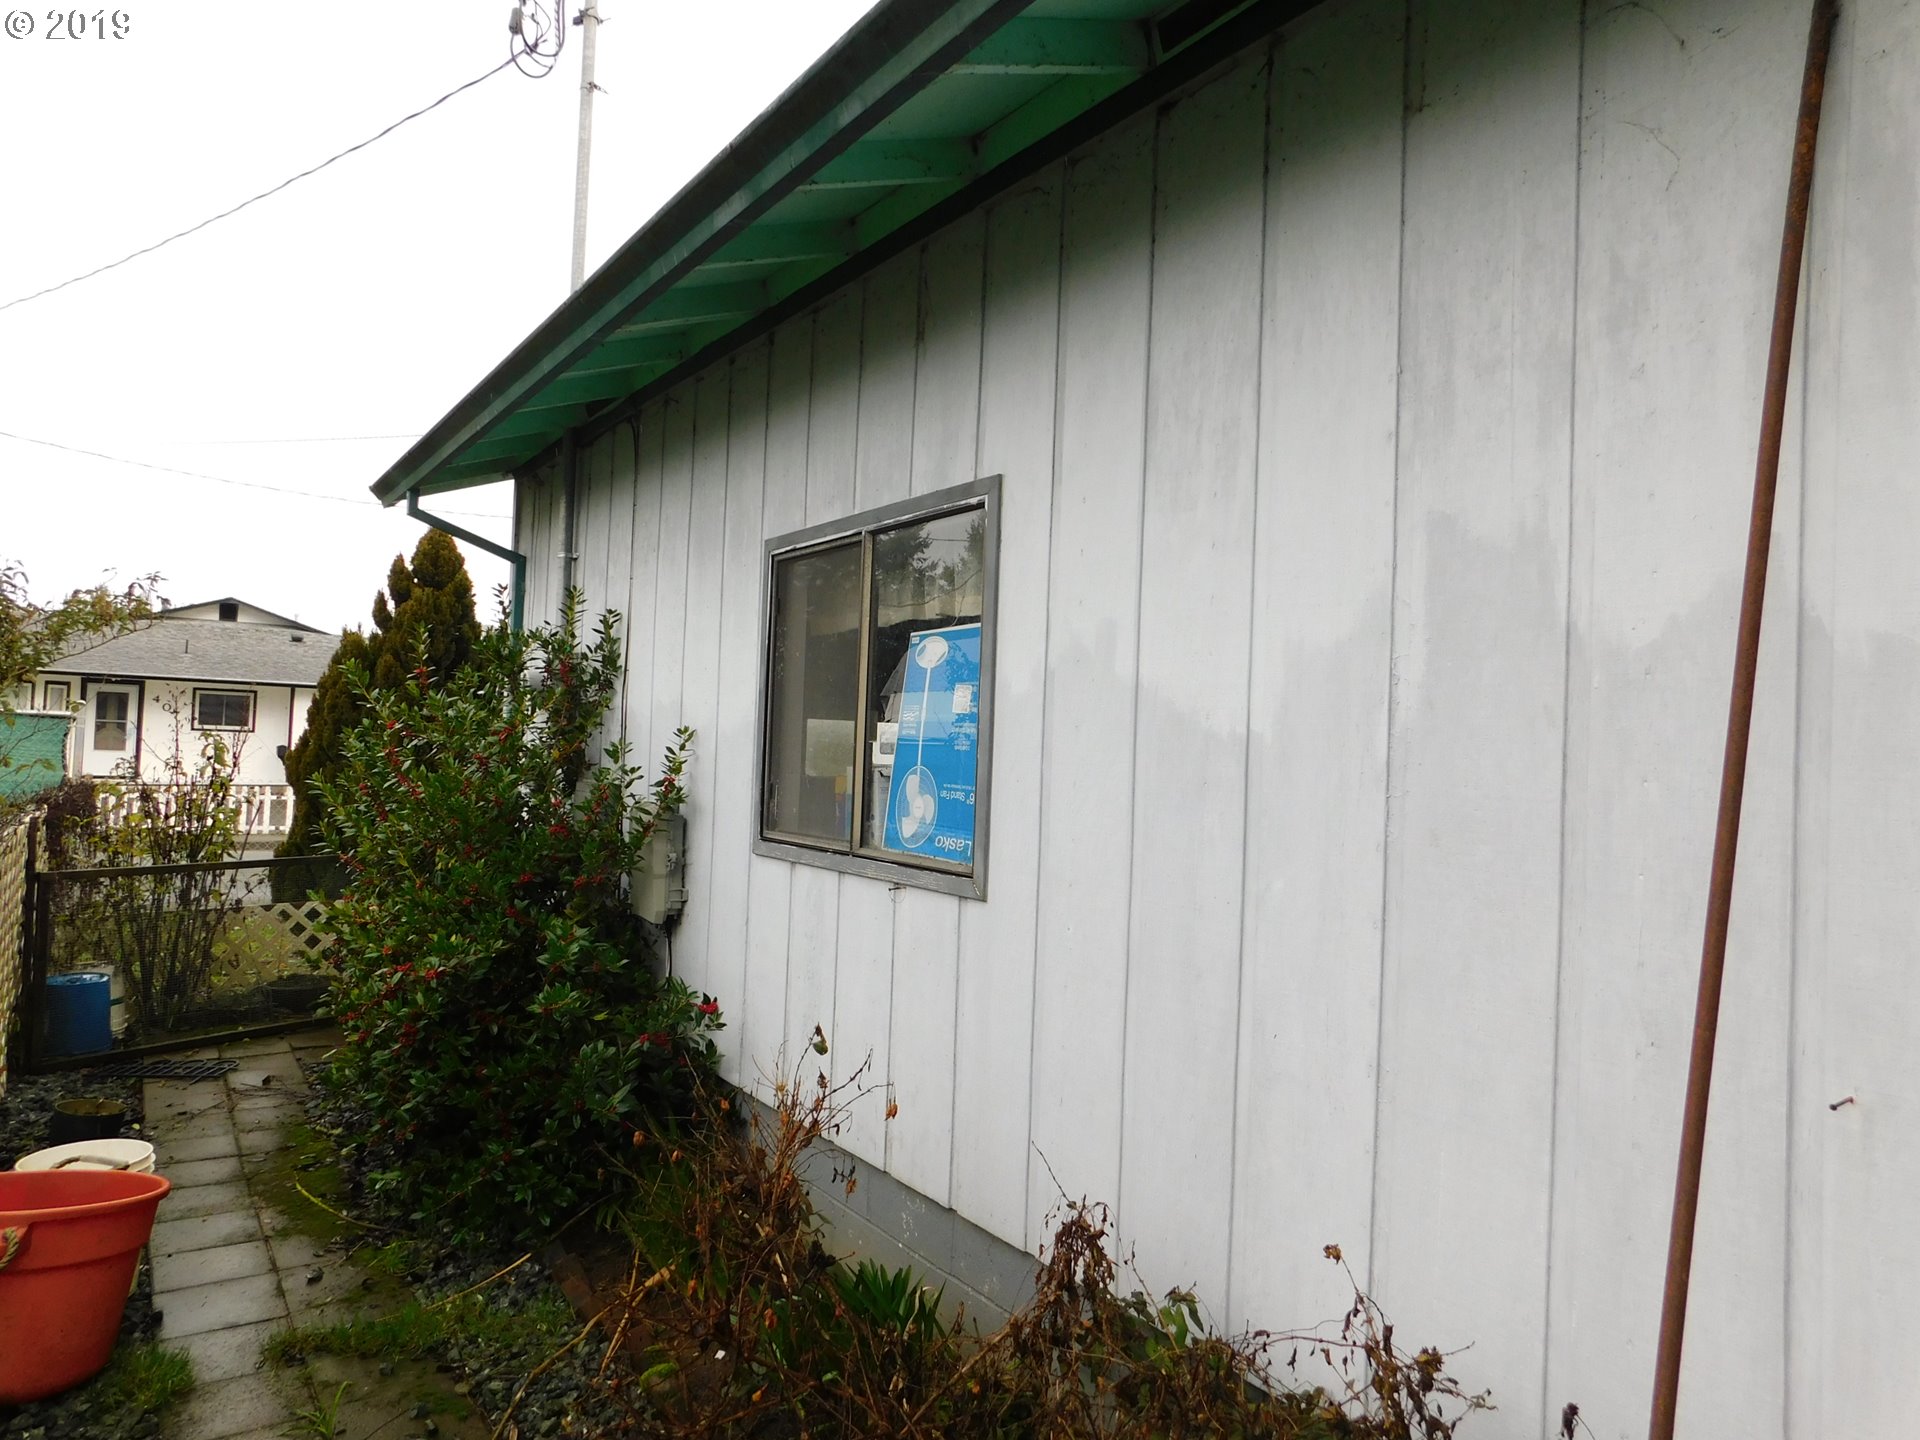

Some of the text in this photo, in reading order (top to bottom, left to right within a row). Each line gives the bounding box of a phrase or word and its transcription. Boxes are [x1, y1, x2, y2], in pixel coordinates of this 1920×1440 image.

[940, 790, 950, 800] Fan
[950, 792, 965, 802] Stand
[935, 835, 972, 857] Lasko
